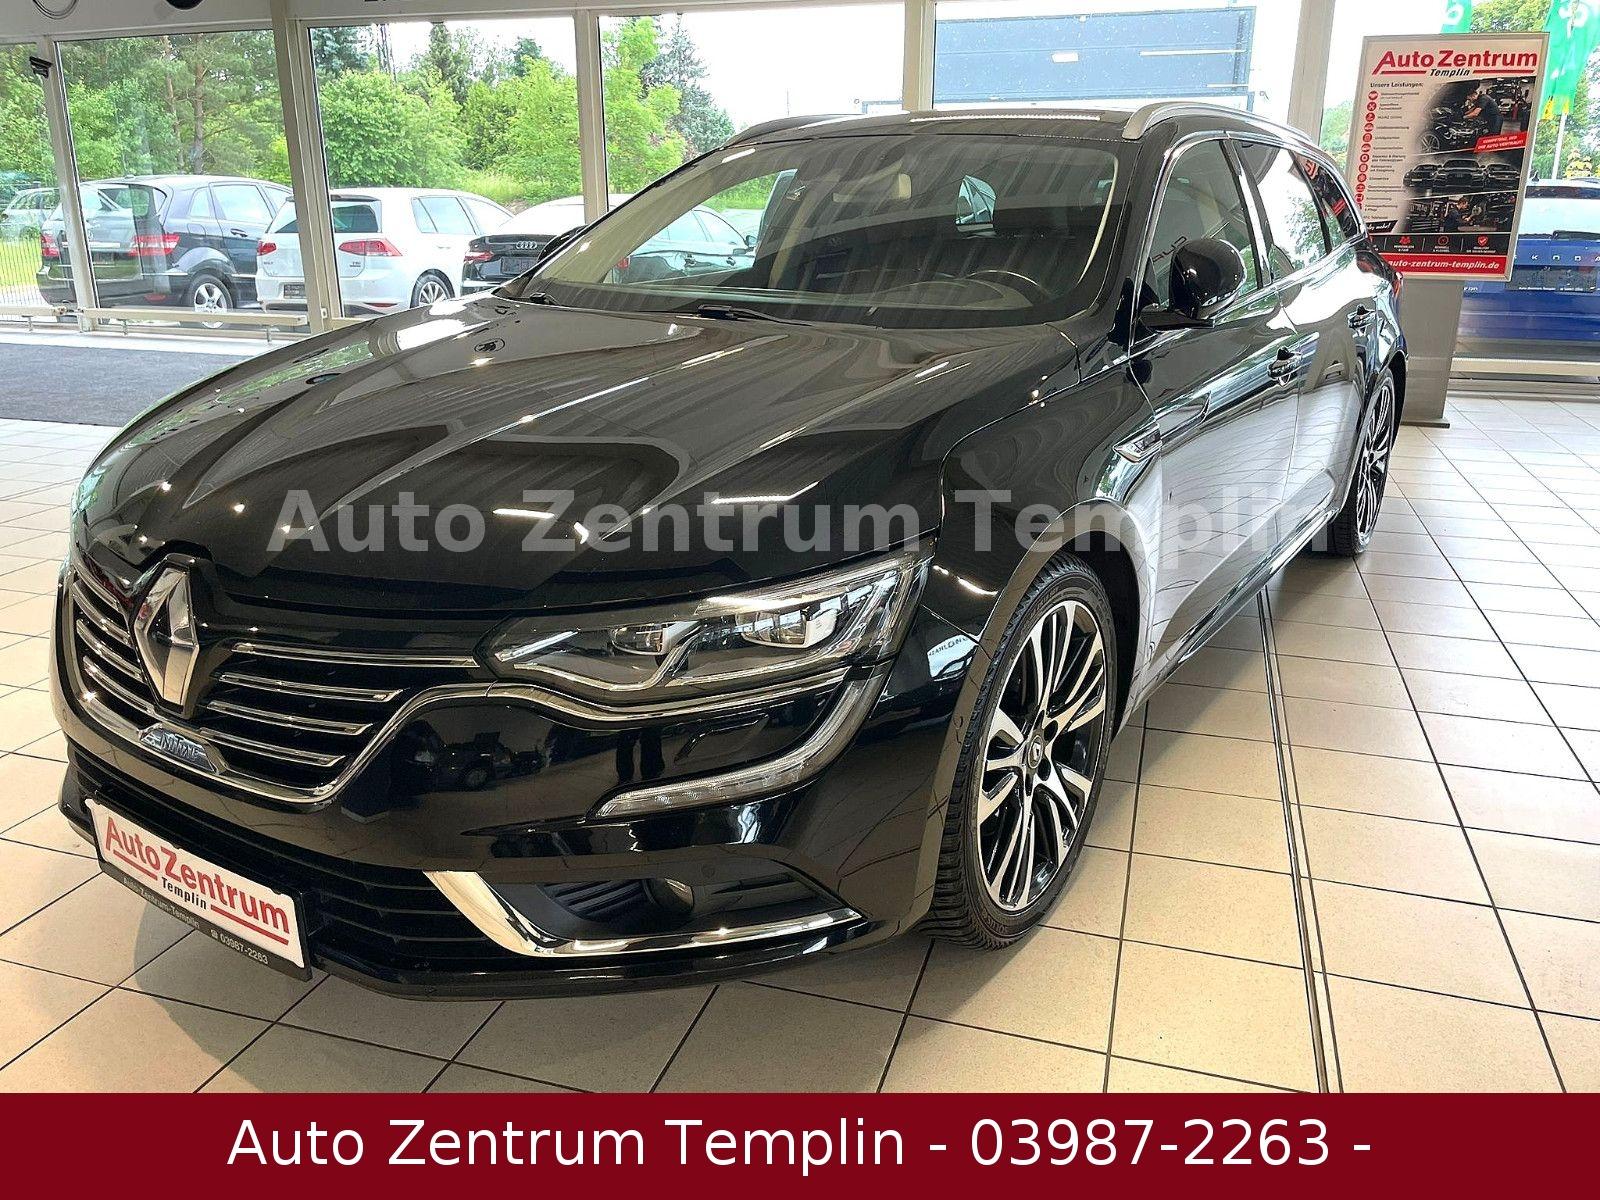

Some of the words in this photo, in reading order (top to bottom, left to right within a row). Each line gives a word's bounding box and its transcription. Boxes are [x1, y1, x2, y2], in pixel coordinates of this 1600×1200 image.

[1372, 50, 1434, 75] Auto
[1437, 50, 1538, 68] Zentrum
[1429, 68, 1471, 77] Templin
[161, 876, 207, 910] Templin
[219, 934, 269, 965] 03987-2263
